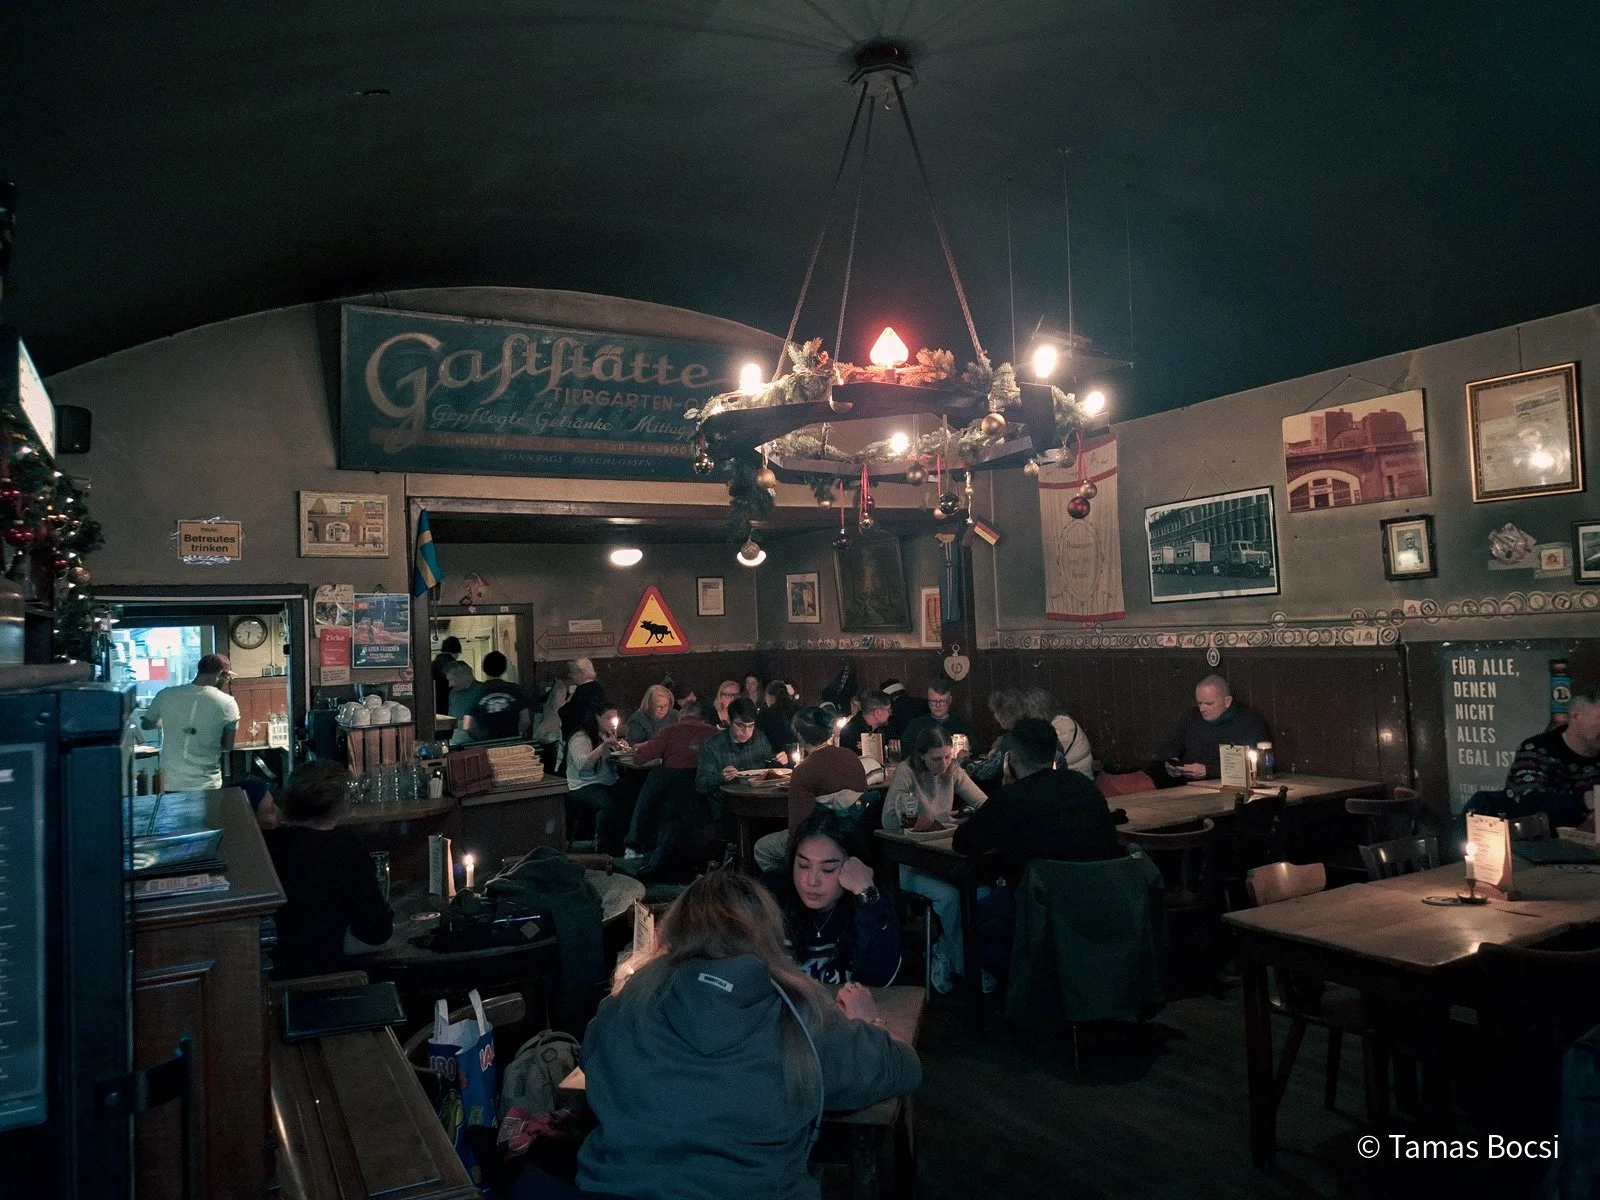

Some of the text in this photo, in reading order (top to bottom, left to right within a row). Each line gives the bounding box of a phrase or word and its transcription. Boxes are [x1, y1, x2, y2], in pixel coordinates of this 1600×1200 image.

[184, 534, 235, 543] Betreutes
[191, 544, 228, 552] trinken
[1452, 656, 1520, 677] FÜR ALLE,
[1453, 681, 1497, 698] DENEN
[1455, 704, 1494, 721] NICHT
[1457, 726, 1496, 743] ALLES
[1458, 748, 1490, 766] EGAL
